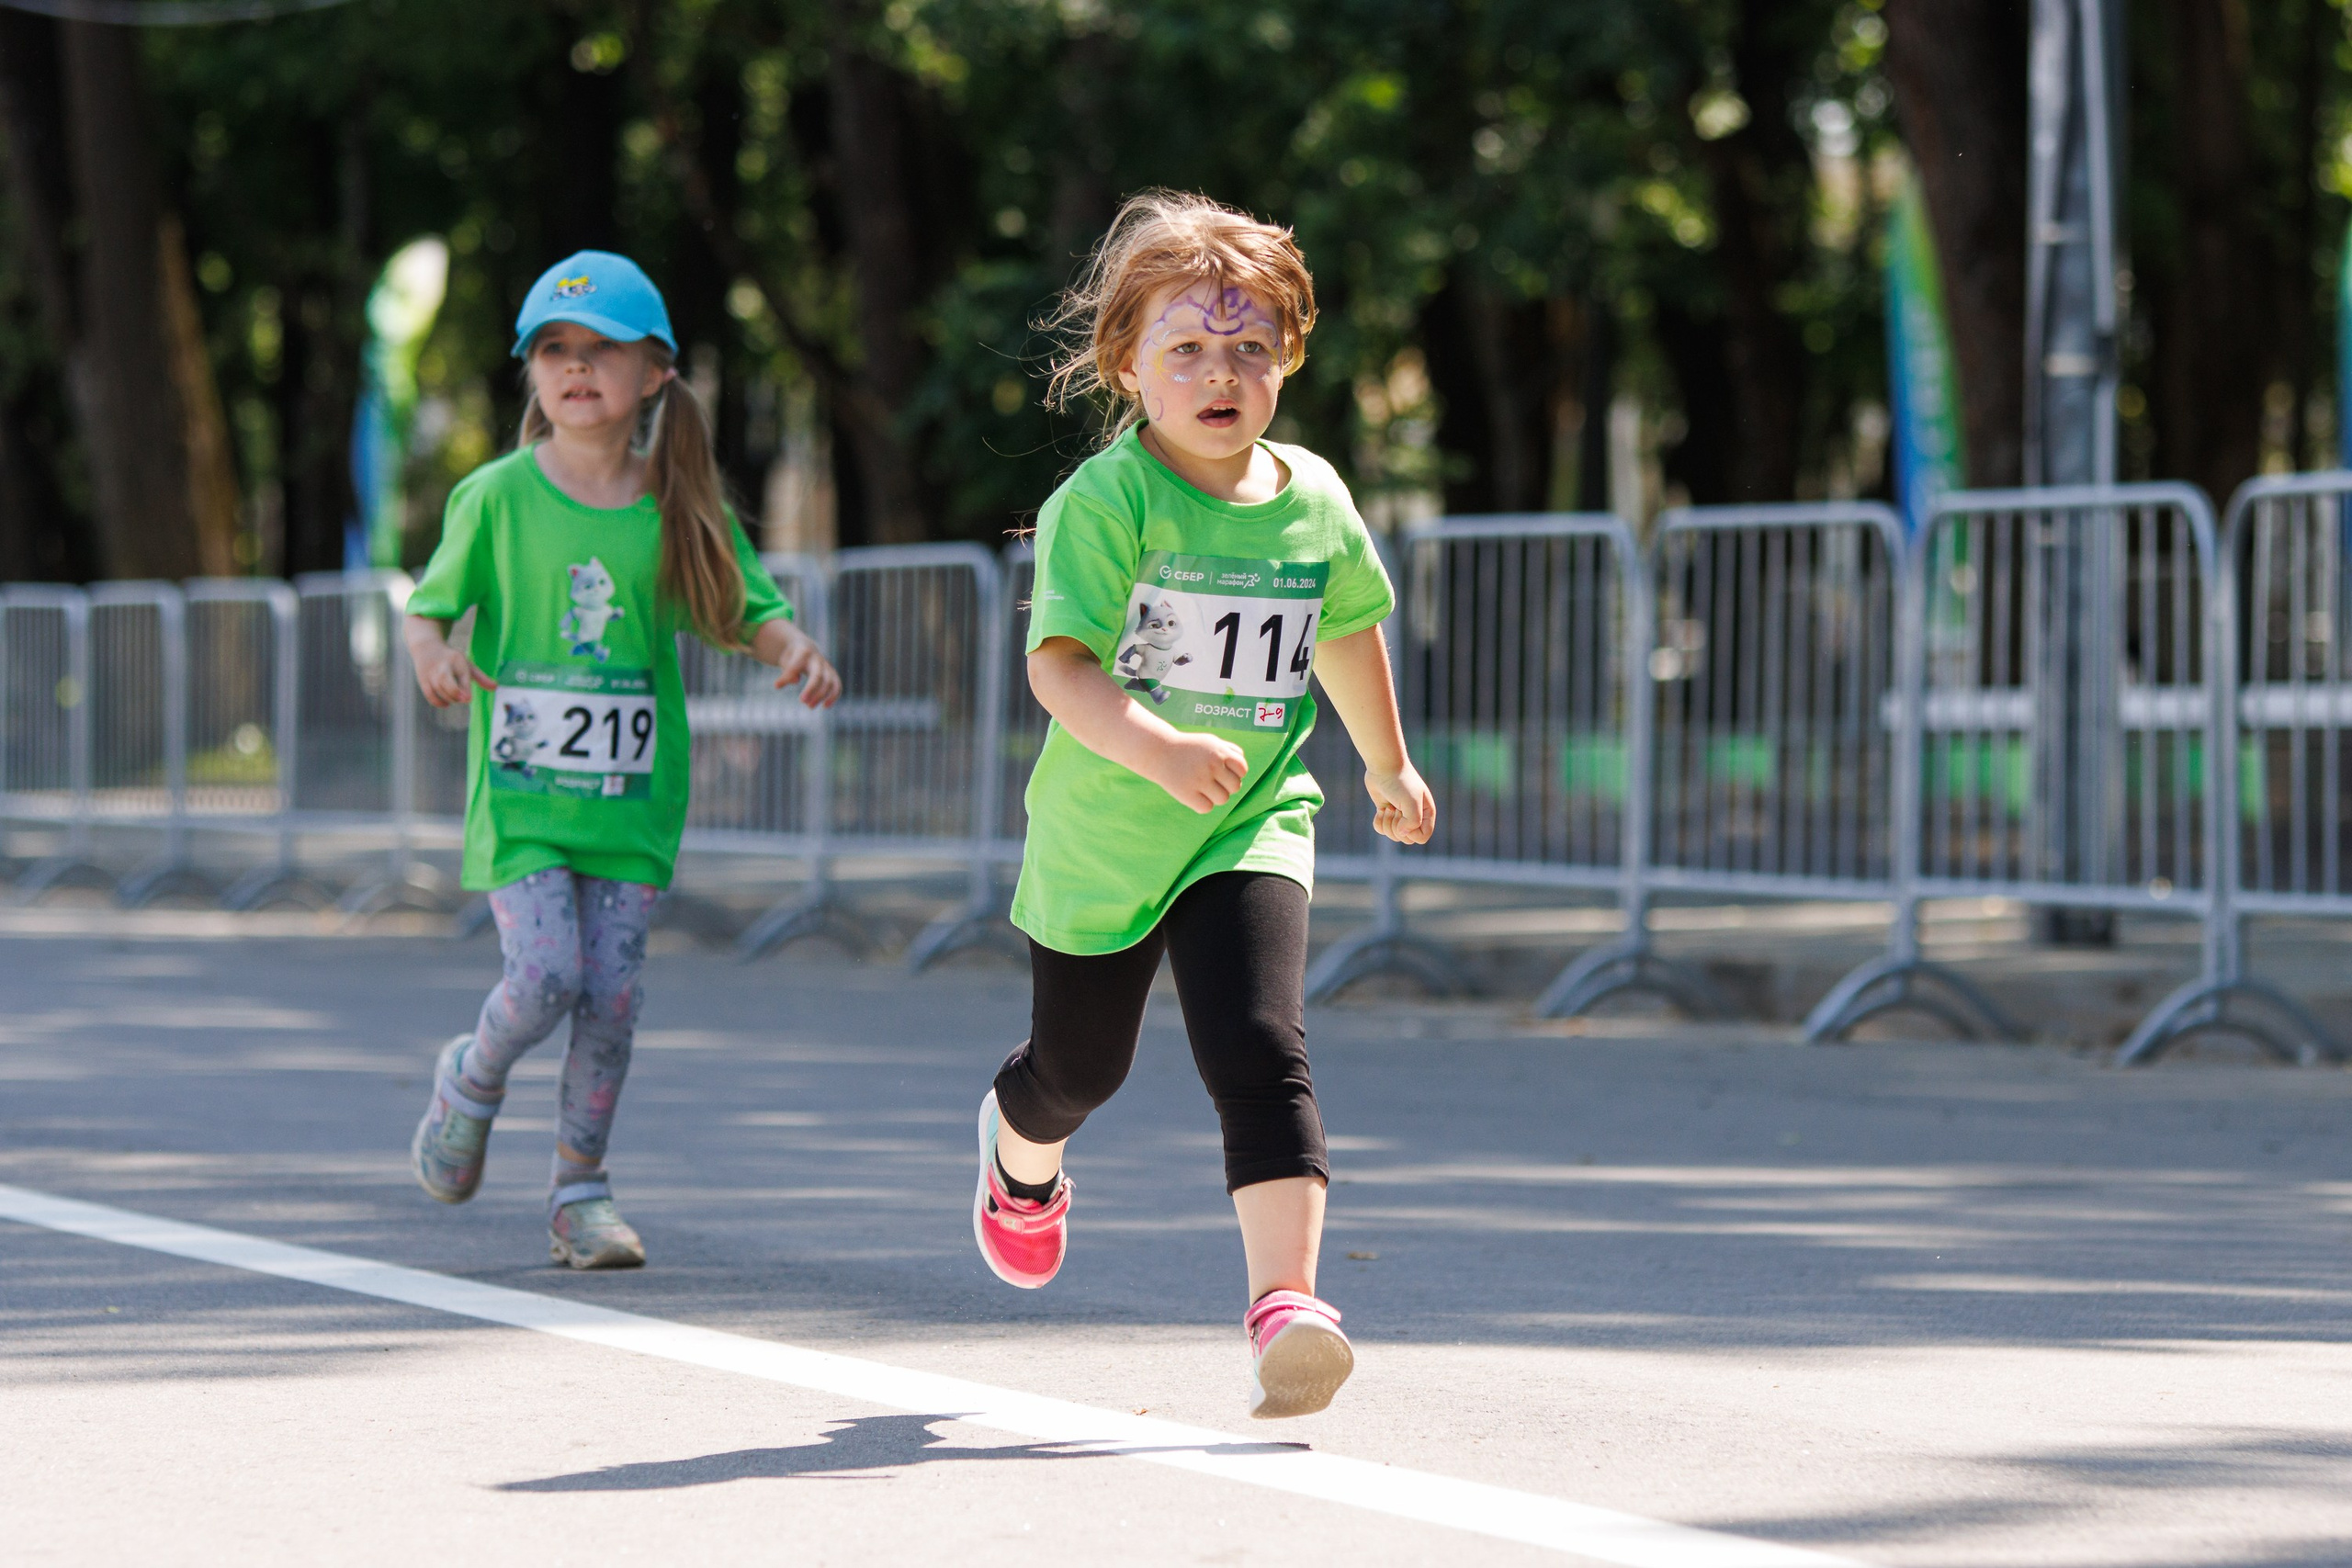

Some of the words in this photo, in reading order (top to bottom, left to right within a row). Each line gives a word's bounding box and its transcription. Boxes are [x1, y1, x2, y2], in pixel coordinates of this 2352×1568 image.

[1174, 570, 1204, 582] СБЕР
[1216, 579, 1244, 587] марафон
[1273, 578, 1316, 589] 01.06.2024
[1214, 612, 1313, 682] 114
[1194, 703, 1251, 718] ВОЗРАСТ
[560, 705, 651, 761] 219
